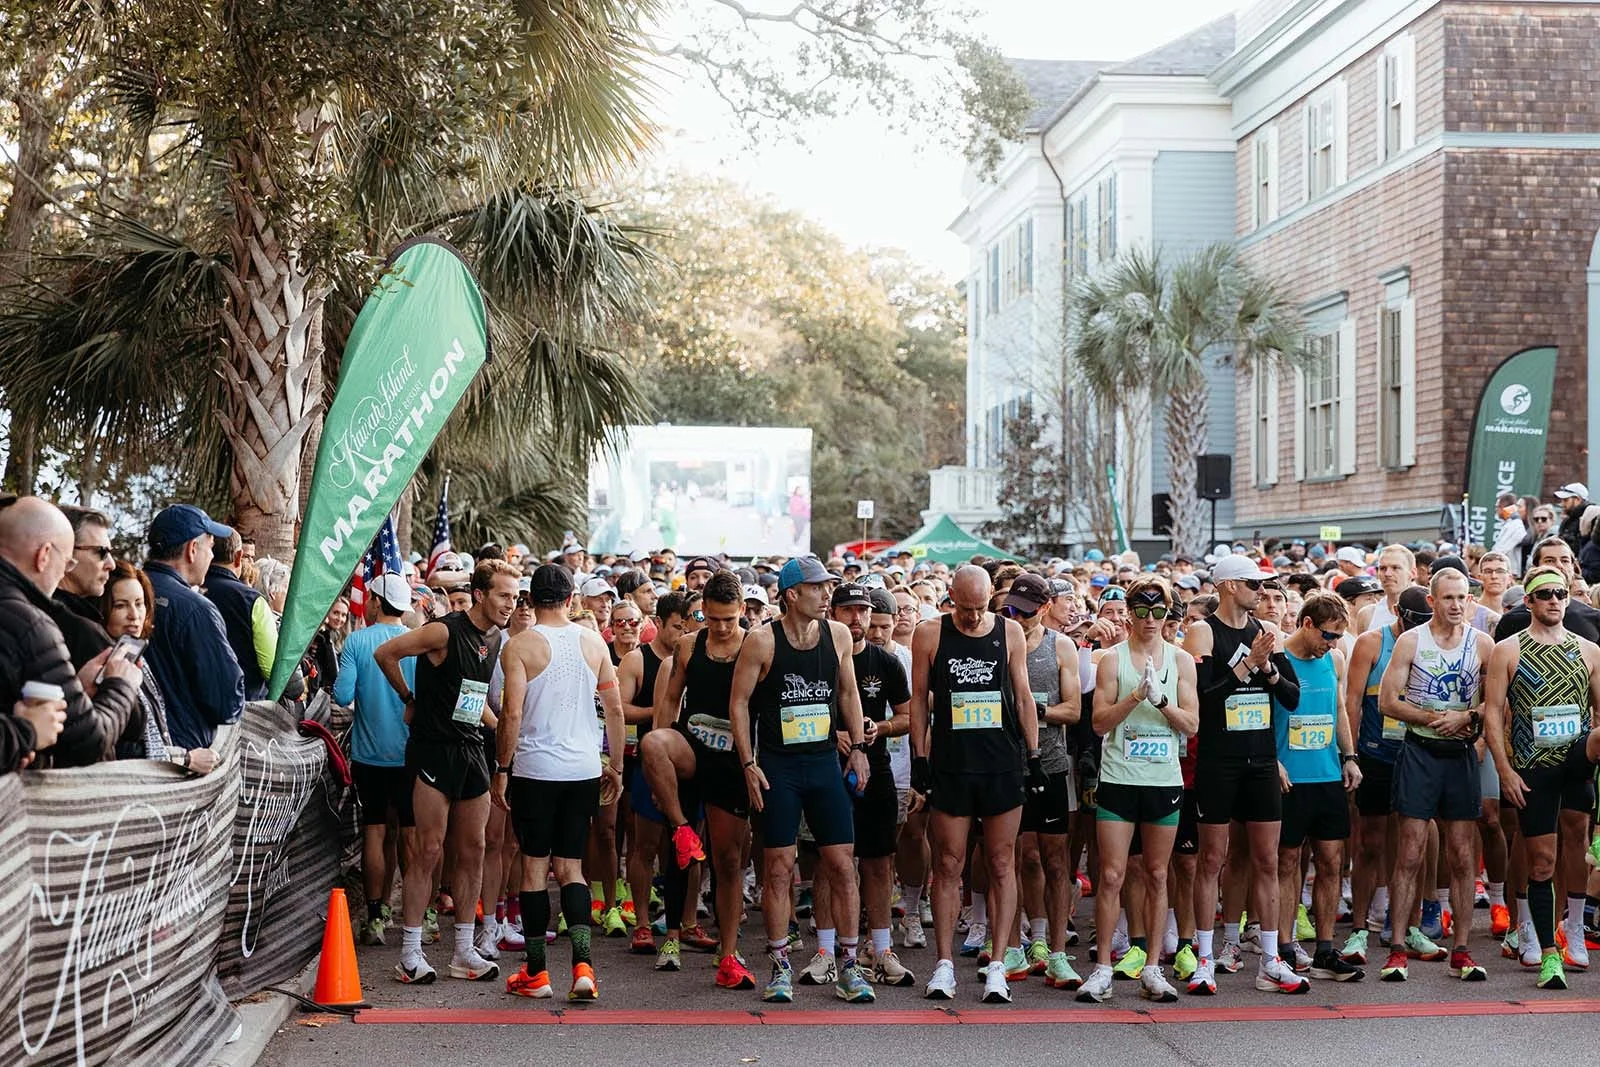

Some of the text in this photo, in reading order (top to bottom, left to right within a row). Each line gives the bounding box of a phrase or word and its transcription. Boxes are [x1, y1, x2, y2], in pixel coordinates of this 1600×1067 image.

[388, 379, 424, 431] GOLF RESORT
[329, 344, 417, 489] Kiawah Island
[1484, 425, 1543, 435] MARATHON
[320, 338, 466, 565] MARATHON
[781, 689, 813, 700] SCENIC
[815, 688, 833, 697] CITY
[460, 695, 484, 714] 2312
[964, 708, 992, 722] 113
[1238, 710, 1263, 724] 125
[798, 721, 816, 737] 31
[1538, 720, 1576, 736] 2310
[1300, 731, 1326, 745] 126
[1130, 742, 1168, 756] 2229
